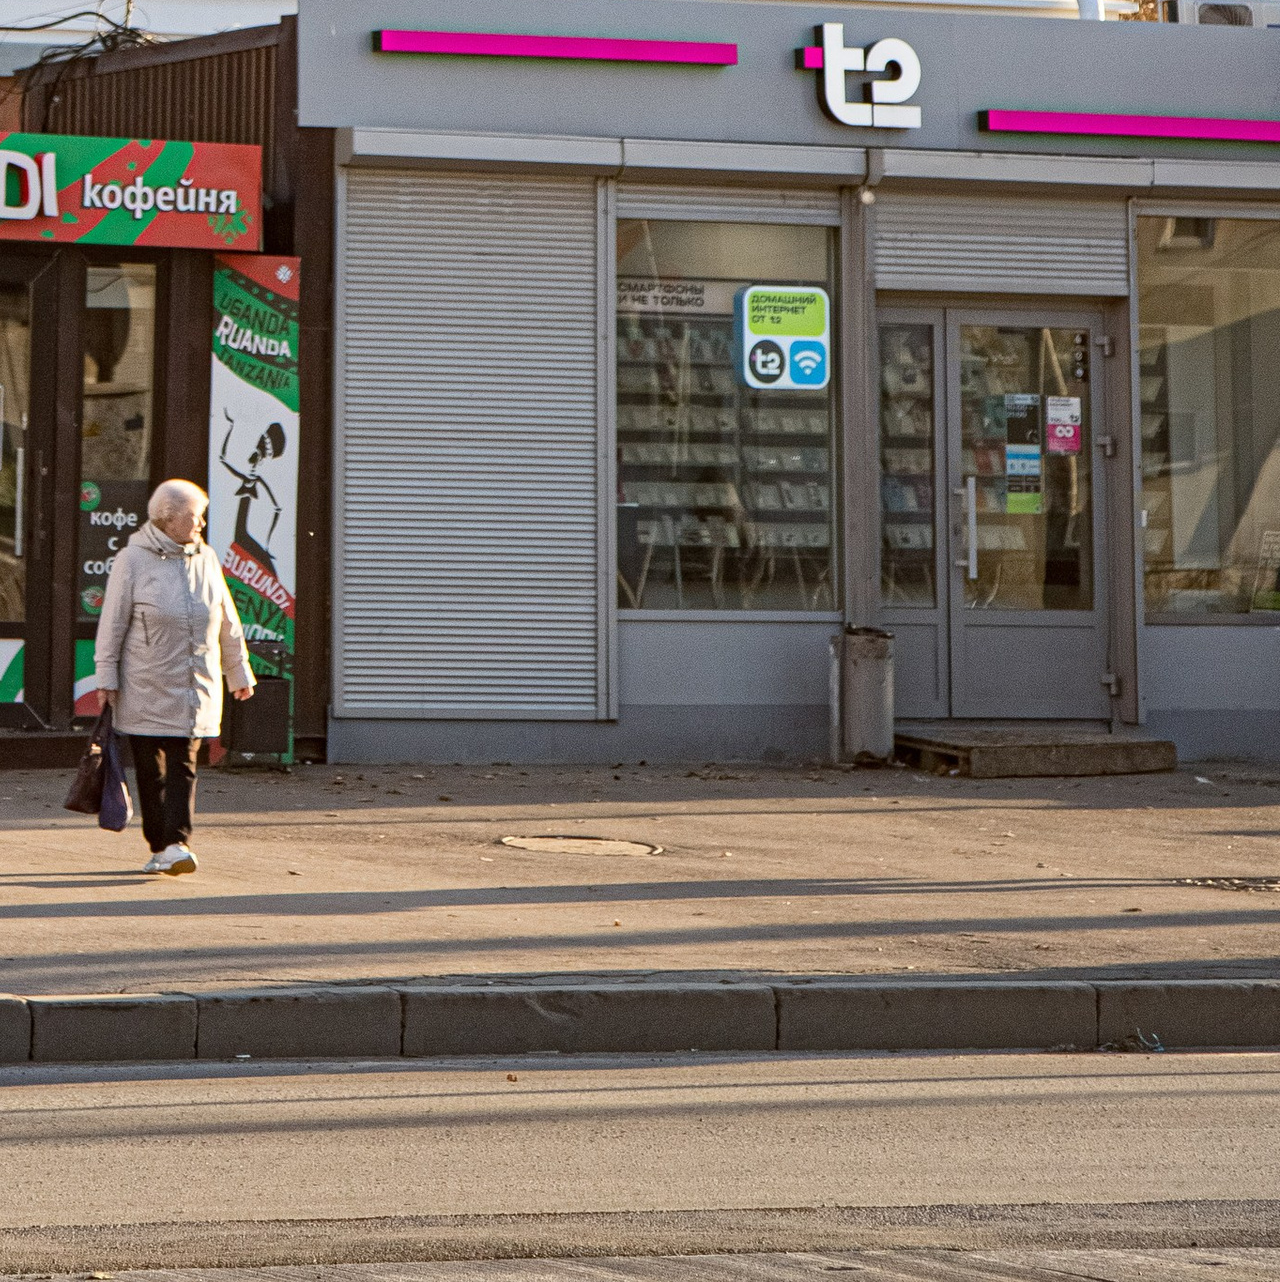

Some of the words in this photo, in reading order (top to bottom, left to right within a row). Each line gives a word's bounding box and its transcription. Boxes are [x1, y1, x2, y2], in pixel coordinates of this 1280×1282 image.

[804, 23, 922, 129] t2
[82, 173, 238, 219] кофейня
[220, 290, 291, 336] UGANDA
[652, 295, 705, 308] ТОЛЬКО
[751, 294, 817, 305] ДОМАШНИЙ
[751, 305, 807, 315] ИНТЕРНЕТ
[751, 315, 766, 325] ОТ
[216, 314, 292, 358] RUANDA
[219, 346, 291, 389] TANZANIA
[751, 348, 781, 376] t2
[90, 507, 139, 531] кофе
[107, 536, 119, 551] с
[228, 583, 289, 637] ENYA
